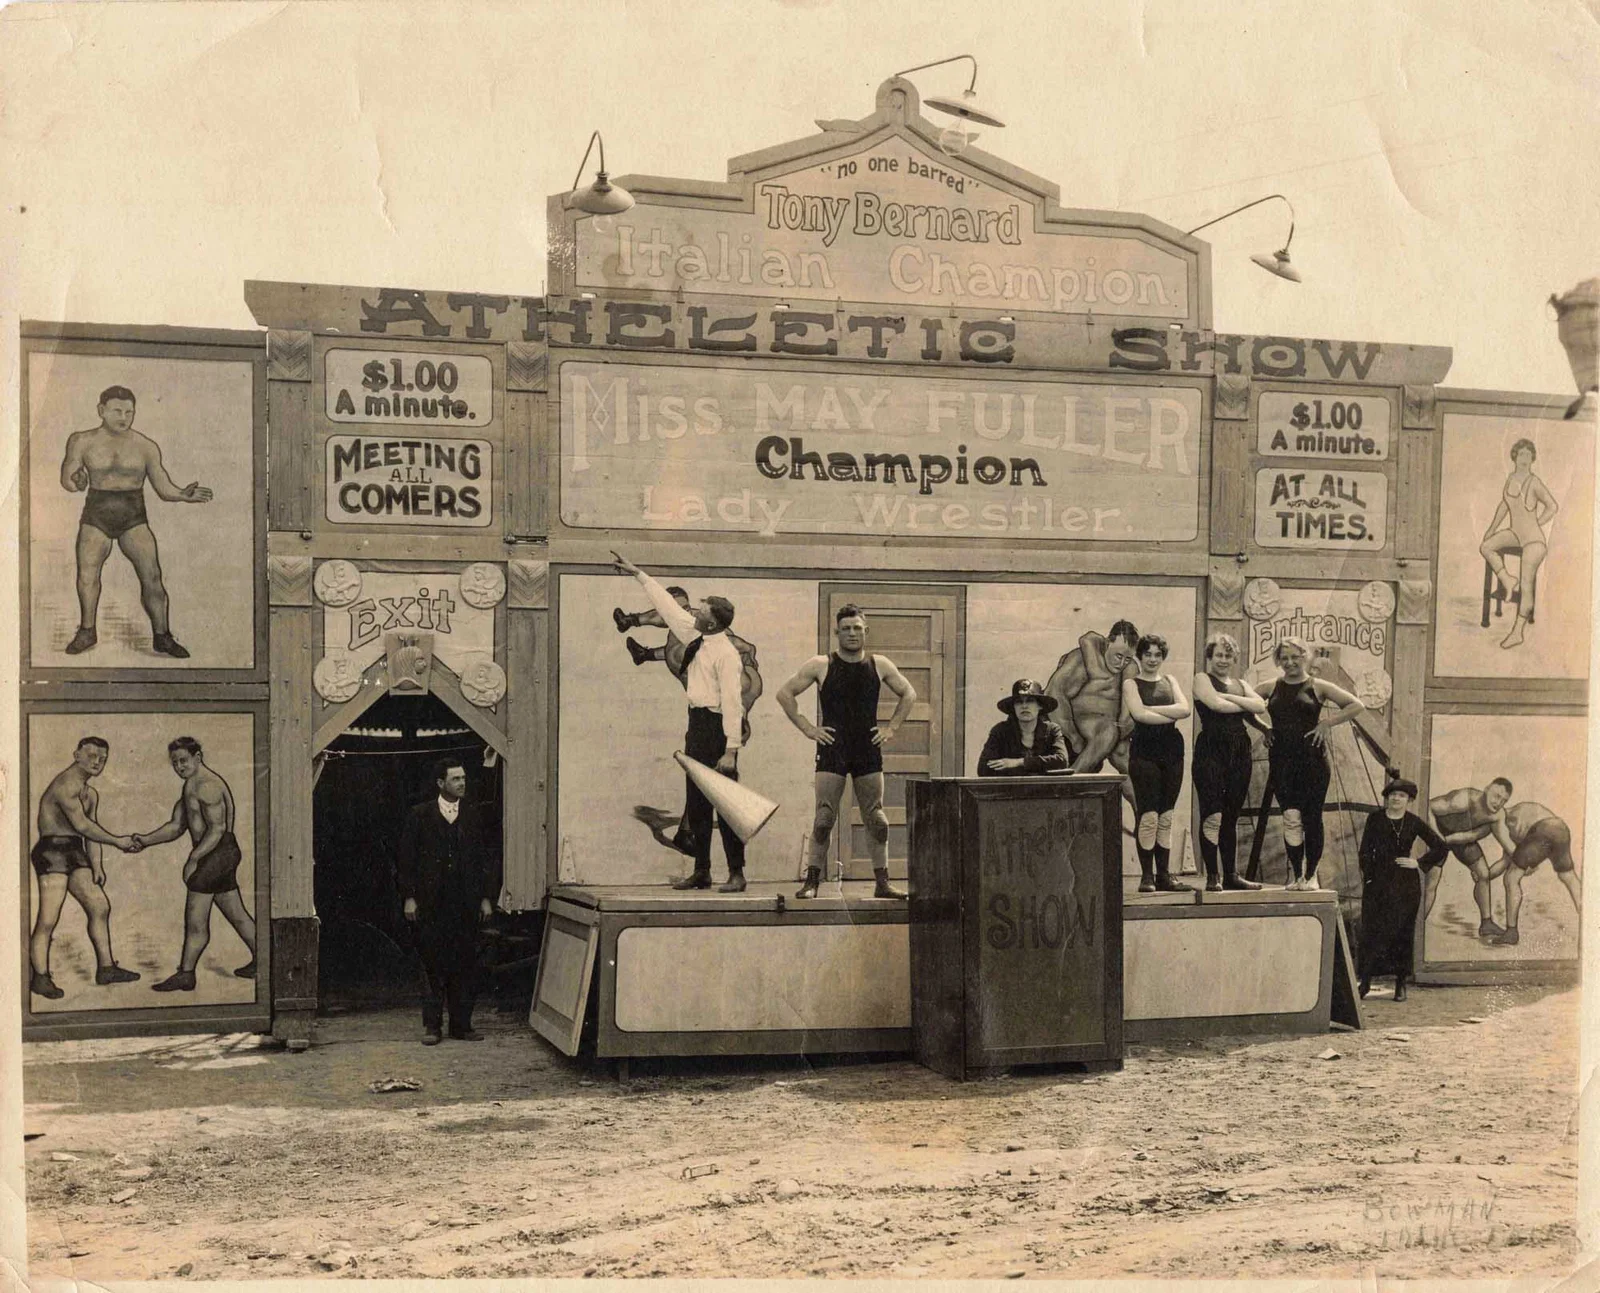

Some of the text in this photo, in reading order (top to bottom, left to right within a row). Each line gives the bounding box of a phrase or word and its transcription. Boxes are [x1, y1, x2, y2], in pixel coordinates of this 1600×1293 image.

[868, 156, 899, 173] one
[761, 185, 1022, 248] Tony Bernard
[614, 224, 1170, 311] Italian Champion
[360, 287, 1382, 381] ATHELETIC SHOW
[361, 358, 459, 394] $1.00
[334, 388, 477, 420] A minute.
[1289, 399, 1364, 431] $1.00
[753, 382, 892, 434] MAY
[925, 389, 1193, 476] FULLER
[1270, 428, 1381, 456] A minute.
[333, 438, 482, 483] MEETING
[388, 466, 433, 485] ALL
[754, 434, 1049, 495] Champion
[338, 481, 483, 519] COMERS
[641, 485, 1134, 537] Lady Wrestler.
[1269, 473, 1367, 509] AT ALL
[1275, 511, 1375, 542] TIMES.
[347, 587, 456, 651] Exit
[1252, 607, 1386, 665] Entrance
[986, 892, 1097, 950] SHOW
